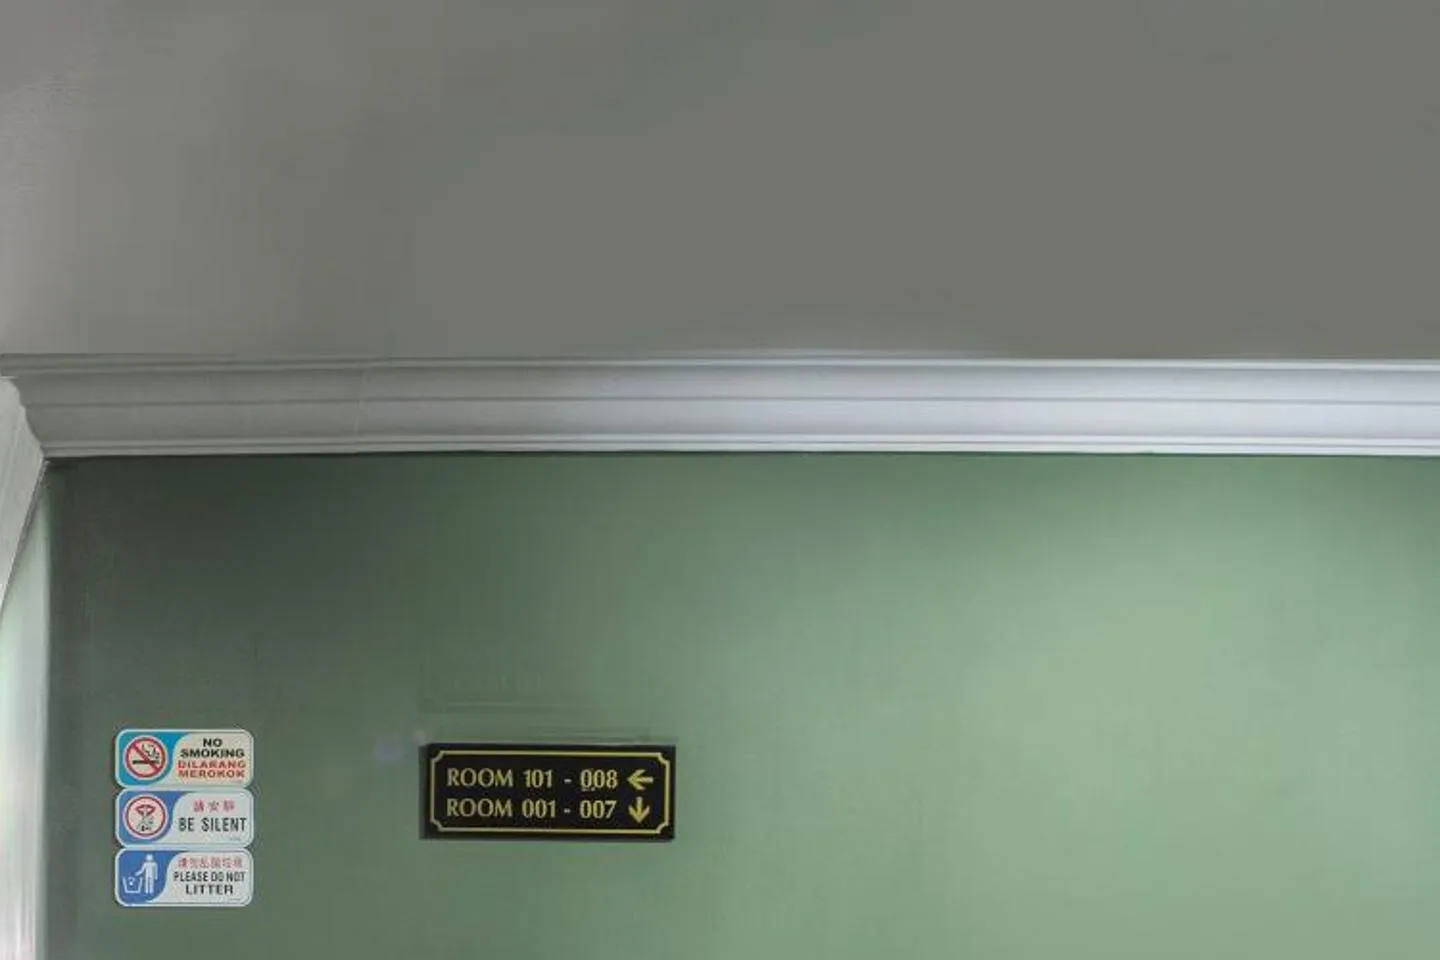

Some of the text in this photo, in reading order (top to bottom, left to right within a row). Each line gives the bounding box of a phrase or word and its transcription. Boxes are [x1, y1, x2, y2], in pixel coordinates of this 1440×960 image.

[203, 738, 222, 747] NO
[180, 748, 245, 758] SMOKING
[178, 760, 246, 768] DILARANG
[178, 770, 245, 778] MEROKOK
[447, 768, 514, 788] ROOM
[523, 769, 553, 788] 101
[580, 768, 618, 789] 008
[446, 798, 513, 818] ROOM
[522, 799, 556, 818] 001
[579, 799, 617, 819] 007
[178, 817, 247, 832] BE SILENT
[173, 871, 246, 882] PLEASE DO NOT
[185, 884, 234, 895] LITTER
